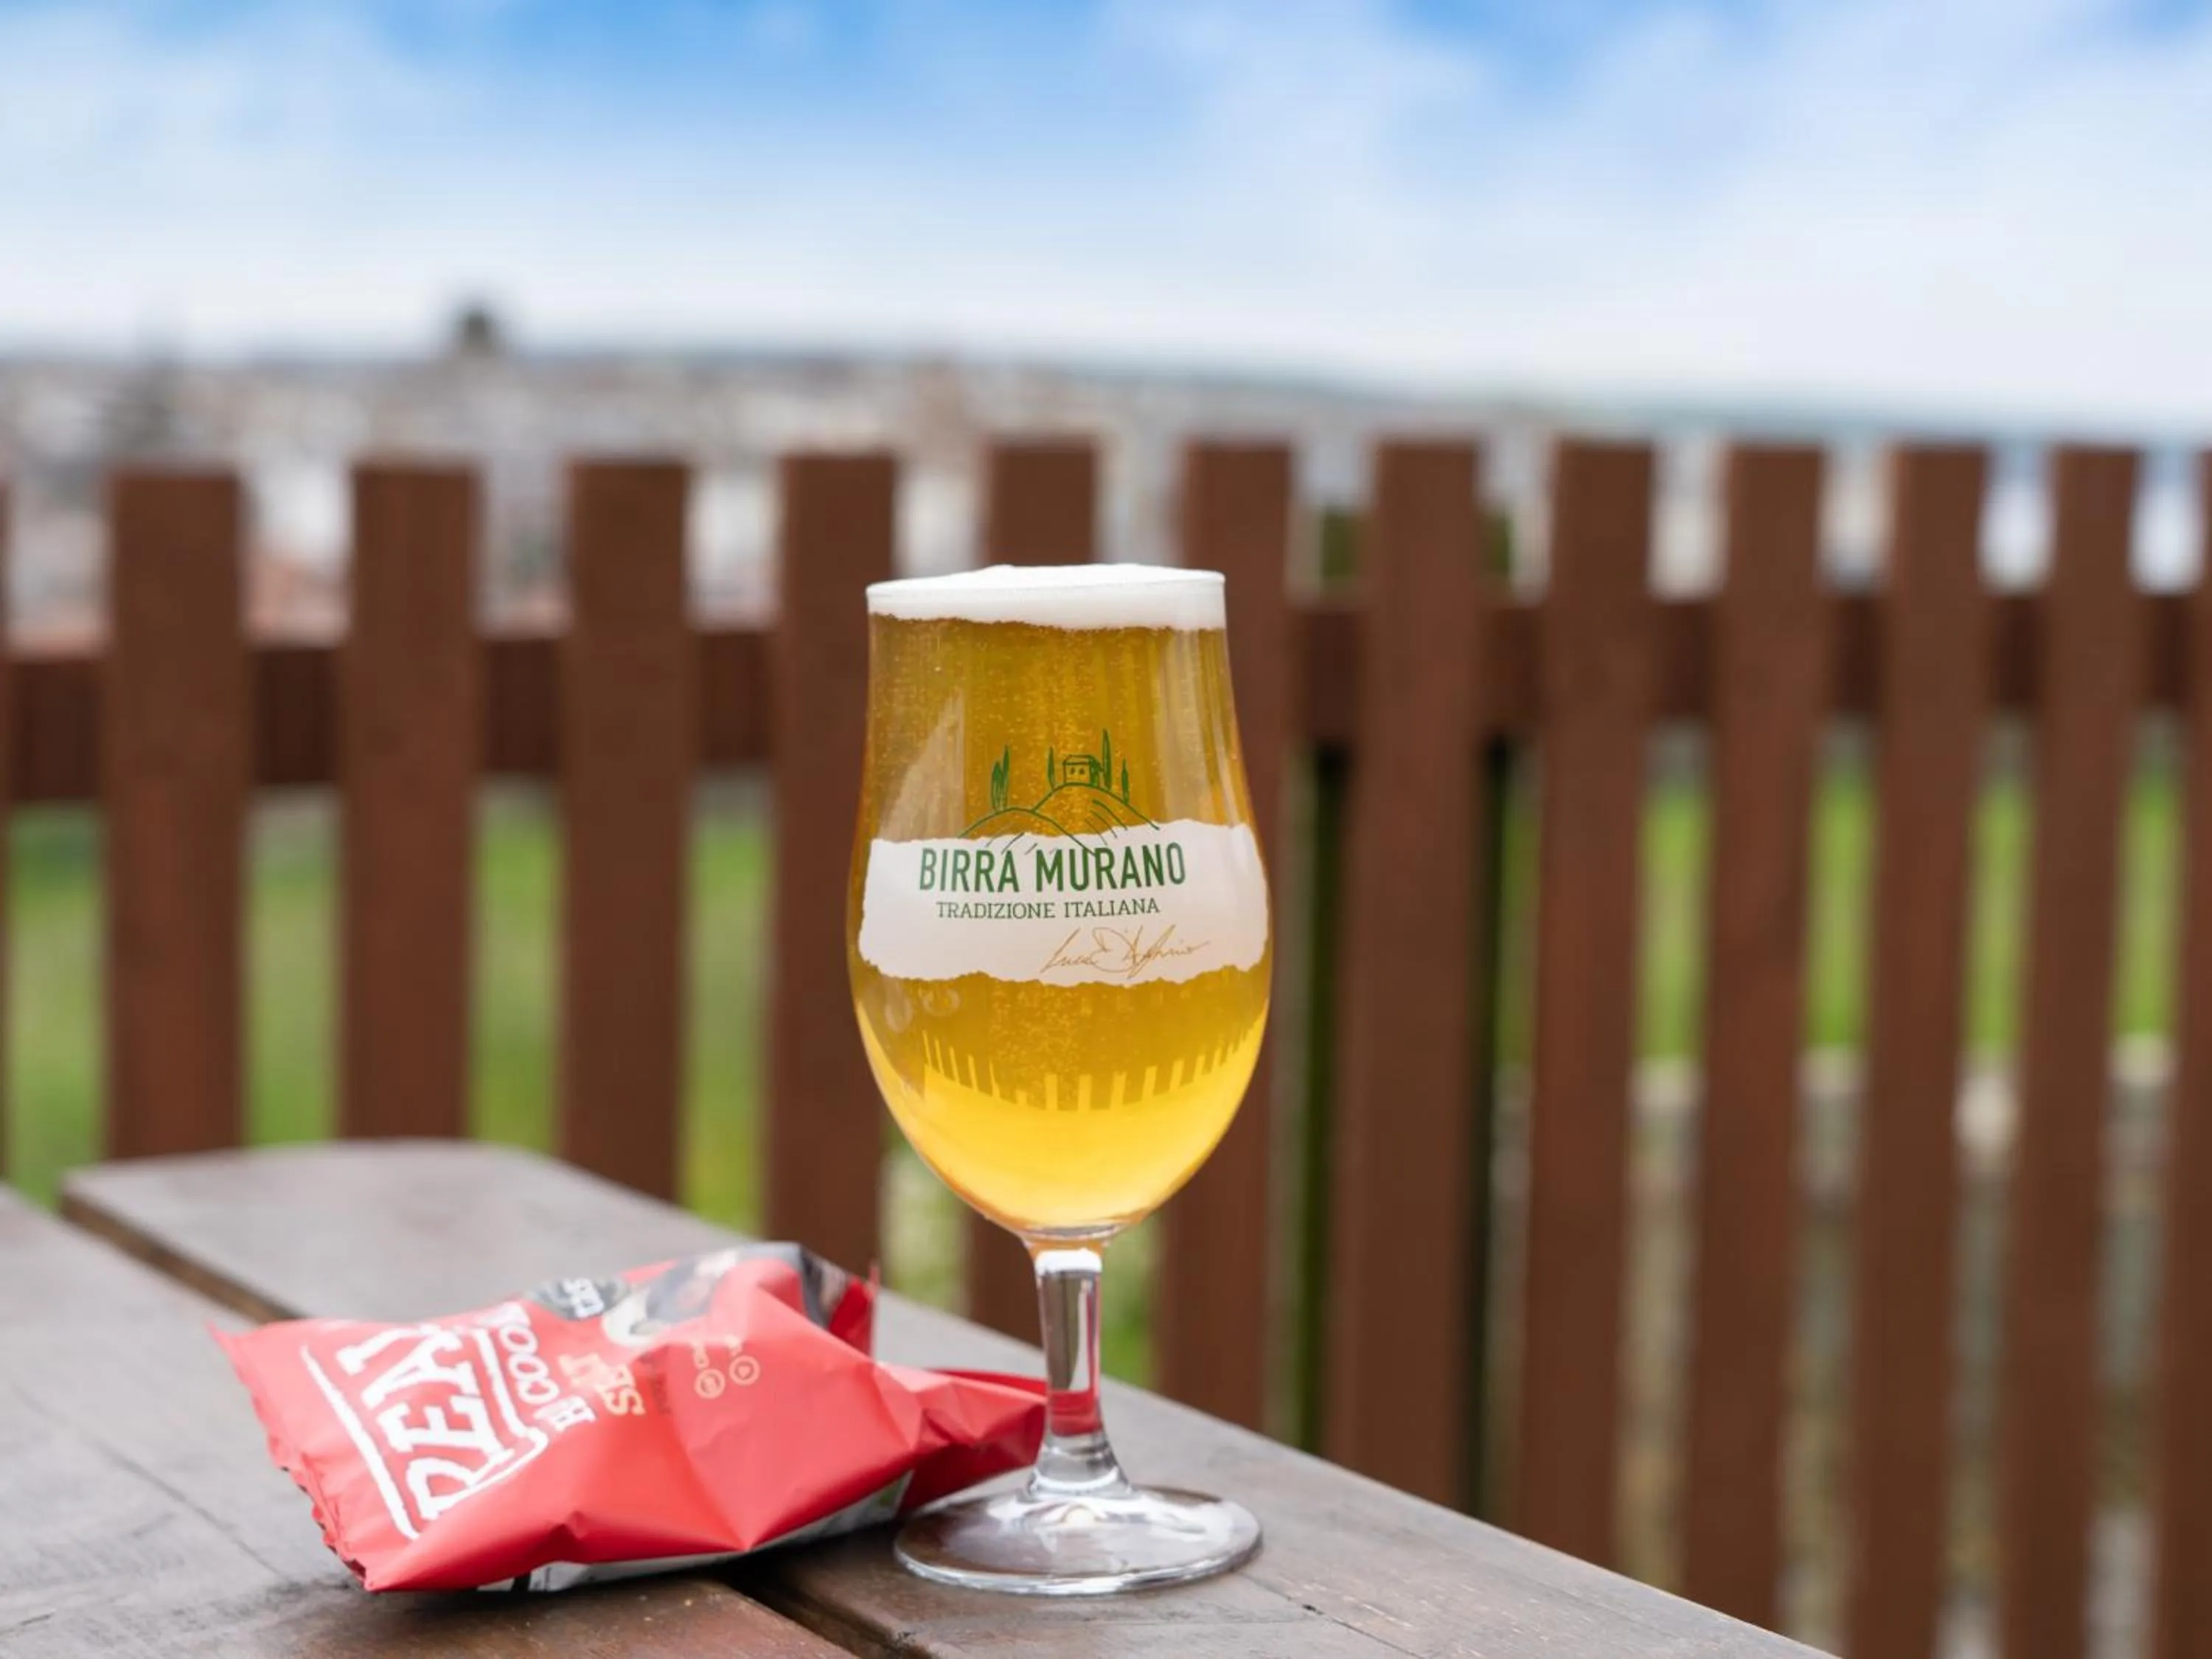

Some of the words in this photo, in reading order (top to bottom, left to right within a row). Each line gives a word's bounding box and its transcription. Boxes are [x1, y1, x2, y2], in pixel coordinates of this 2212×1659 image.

[919, 849, 1019, 892] BIRRA
[1037, 843, 1186, 891] MURANO
[936, 901, 1056, 919] TRADIZIONE
[1064, 898, 1160, 918] ITALIANA
